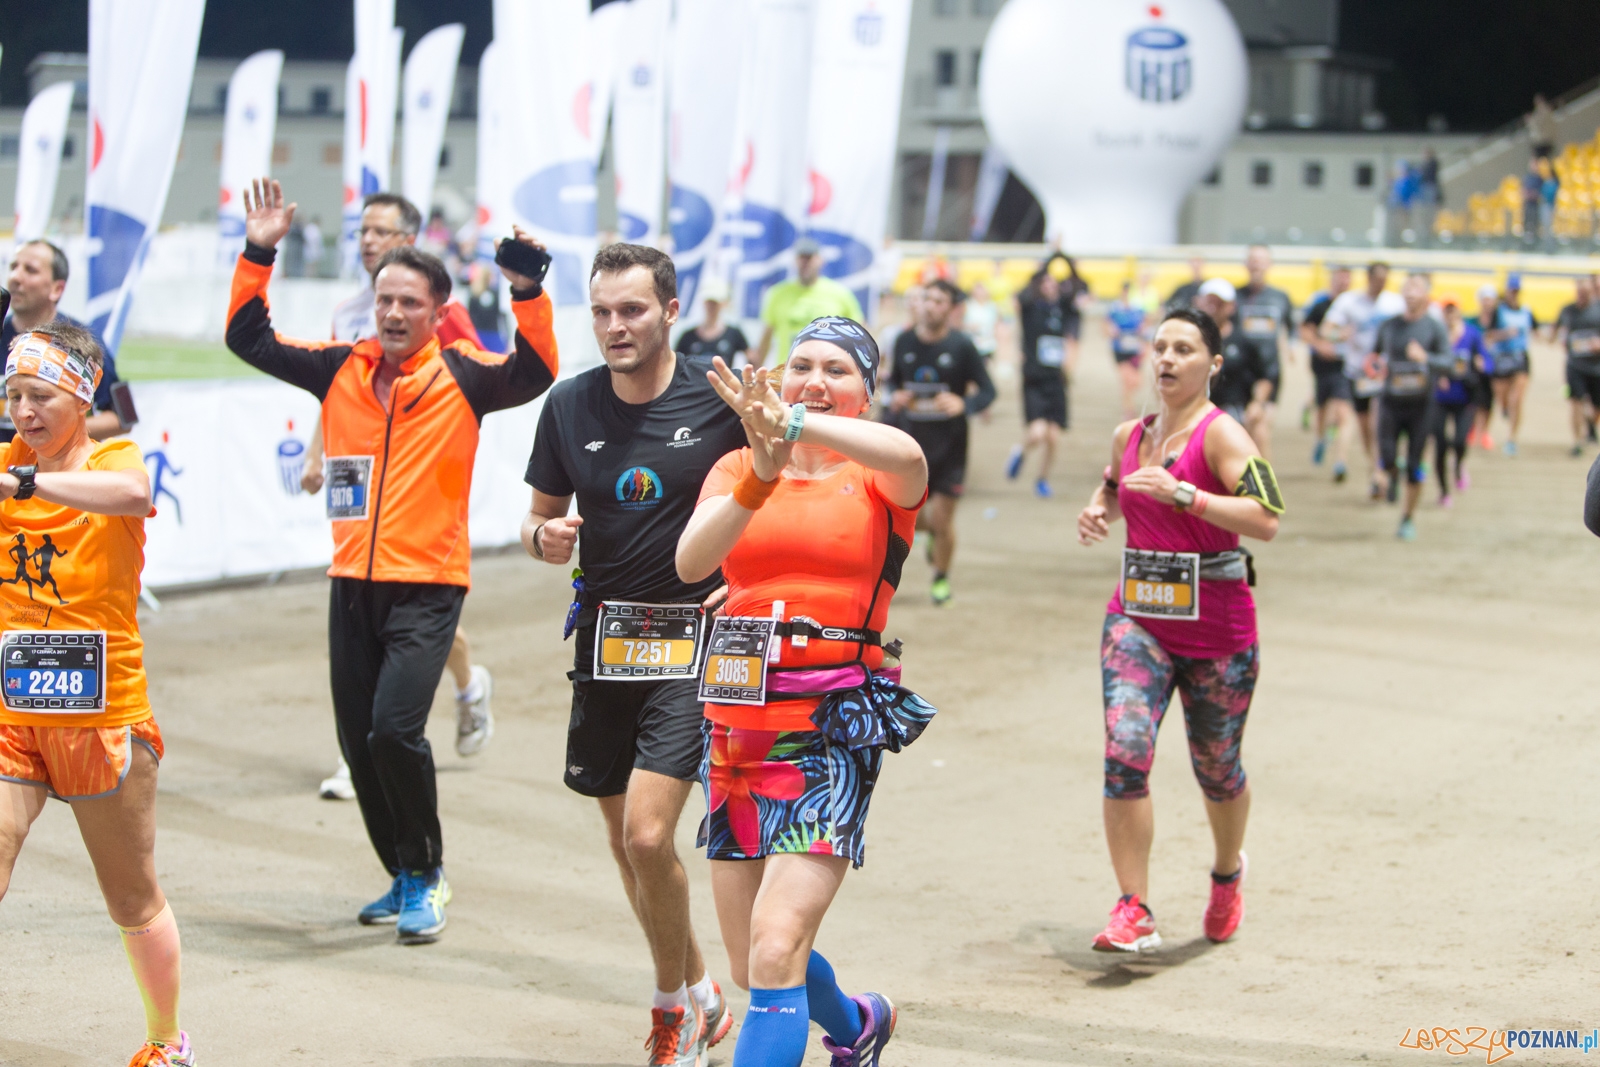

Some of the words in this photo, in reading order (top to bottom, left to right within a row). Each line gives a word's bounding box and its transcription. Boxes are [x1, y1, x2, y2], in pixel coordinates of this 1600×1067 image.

[584, 440, 606, 452] 4F
[1135, 582, 1175, 604] 8348
[623, 641, 672, 664] 7251
[715, 657, 749, 684] 3085
[28, 670, 83, 695] 2248
[569, 764, 584, 777] 4F
